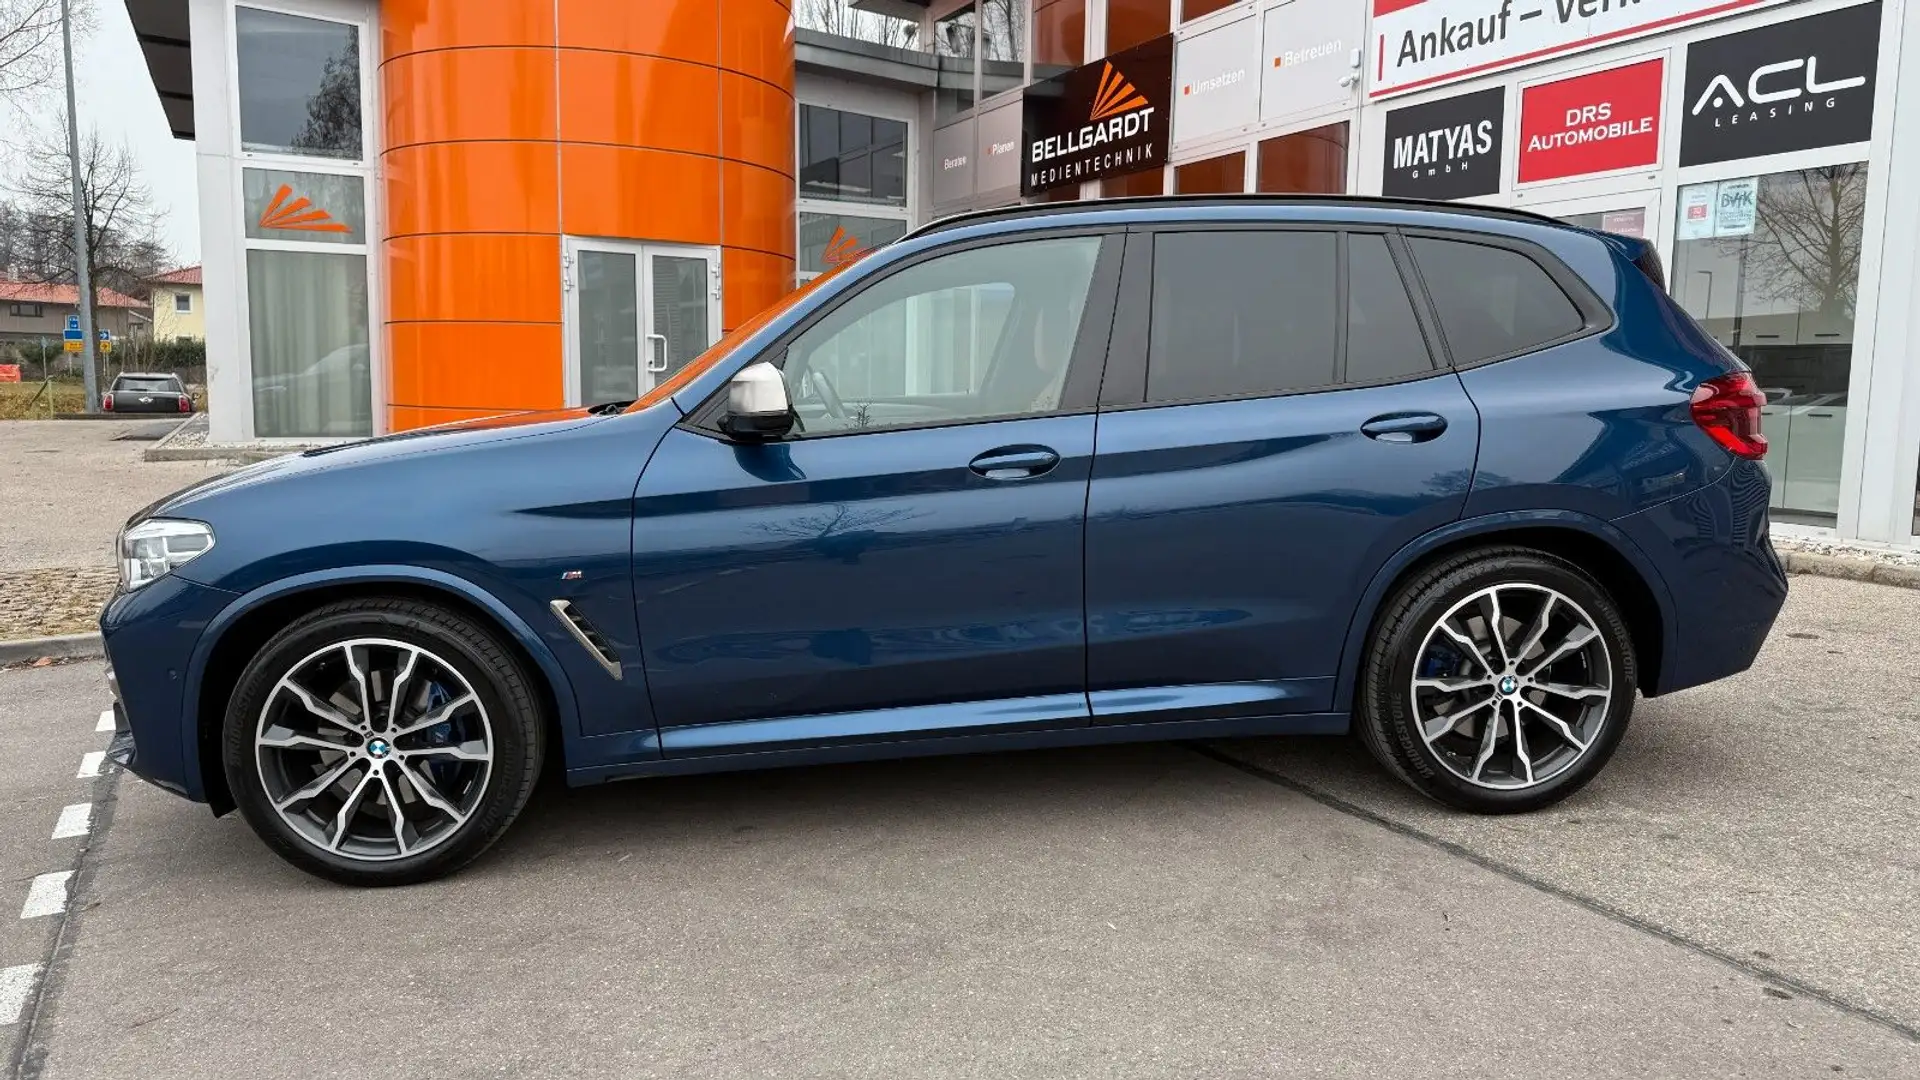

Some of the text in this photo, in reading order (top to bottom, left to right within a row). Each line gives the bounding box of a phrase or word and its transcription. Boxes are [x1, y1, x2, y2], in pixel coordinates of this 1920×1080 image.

[1397, 0, 1513, 67] Ankauf
[1556, 0, 1641, 23] Ve
[1284, 38, 1342, 67] Betreuen
[1192, 69, 1245, 95] Umsetzen
[1692, 56, 1866, 116] ACL
[1565, 102, 1612, 127] DRS
[1714, 97, 1835, 128] LEASING
[992, 142, 1015, 156] Planen
[1032, 107, 1155, 163] BELLGARDT
[1393, 119, 1493, 169] MATYAS
[1527, 116, 1654, 152] AUTOMOBILE
[944, 156, 967, 170] Beraten
[1031, 143, 1153, 188] MEDIENTECHNIK
